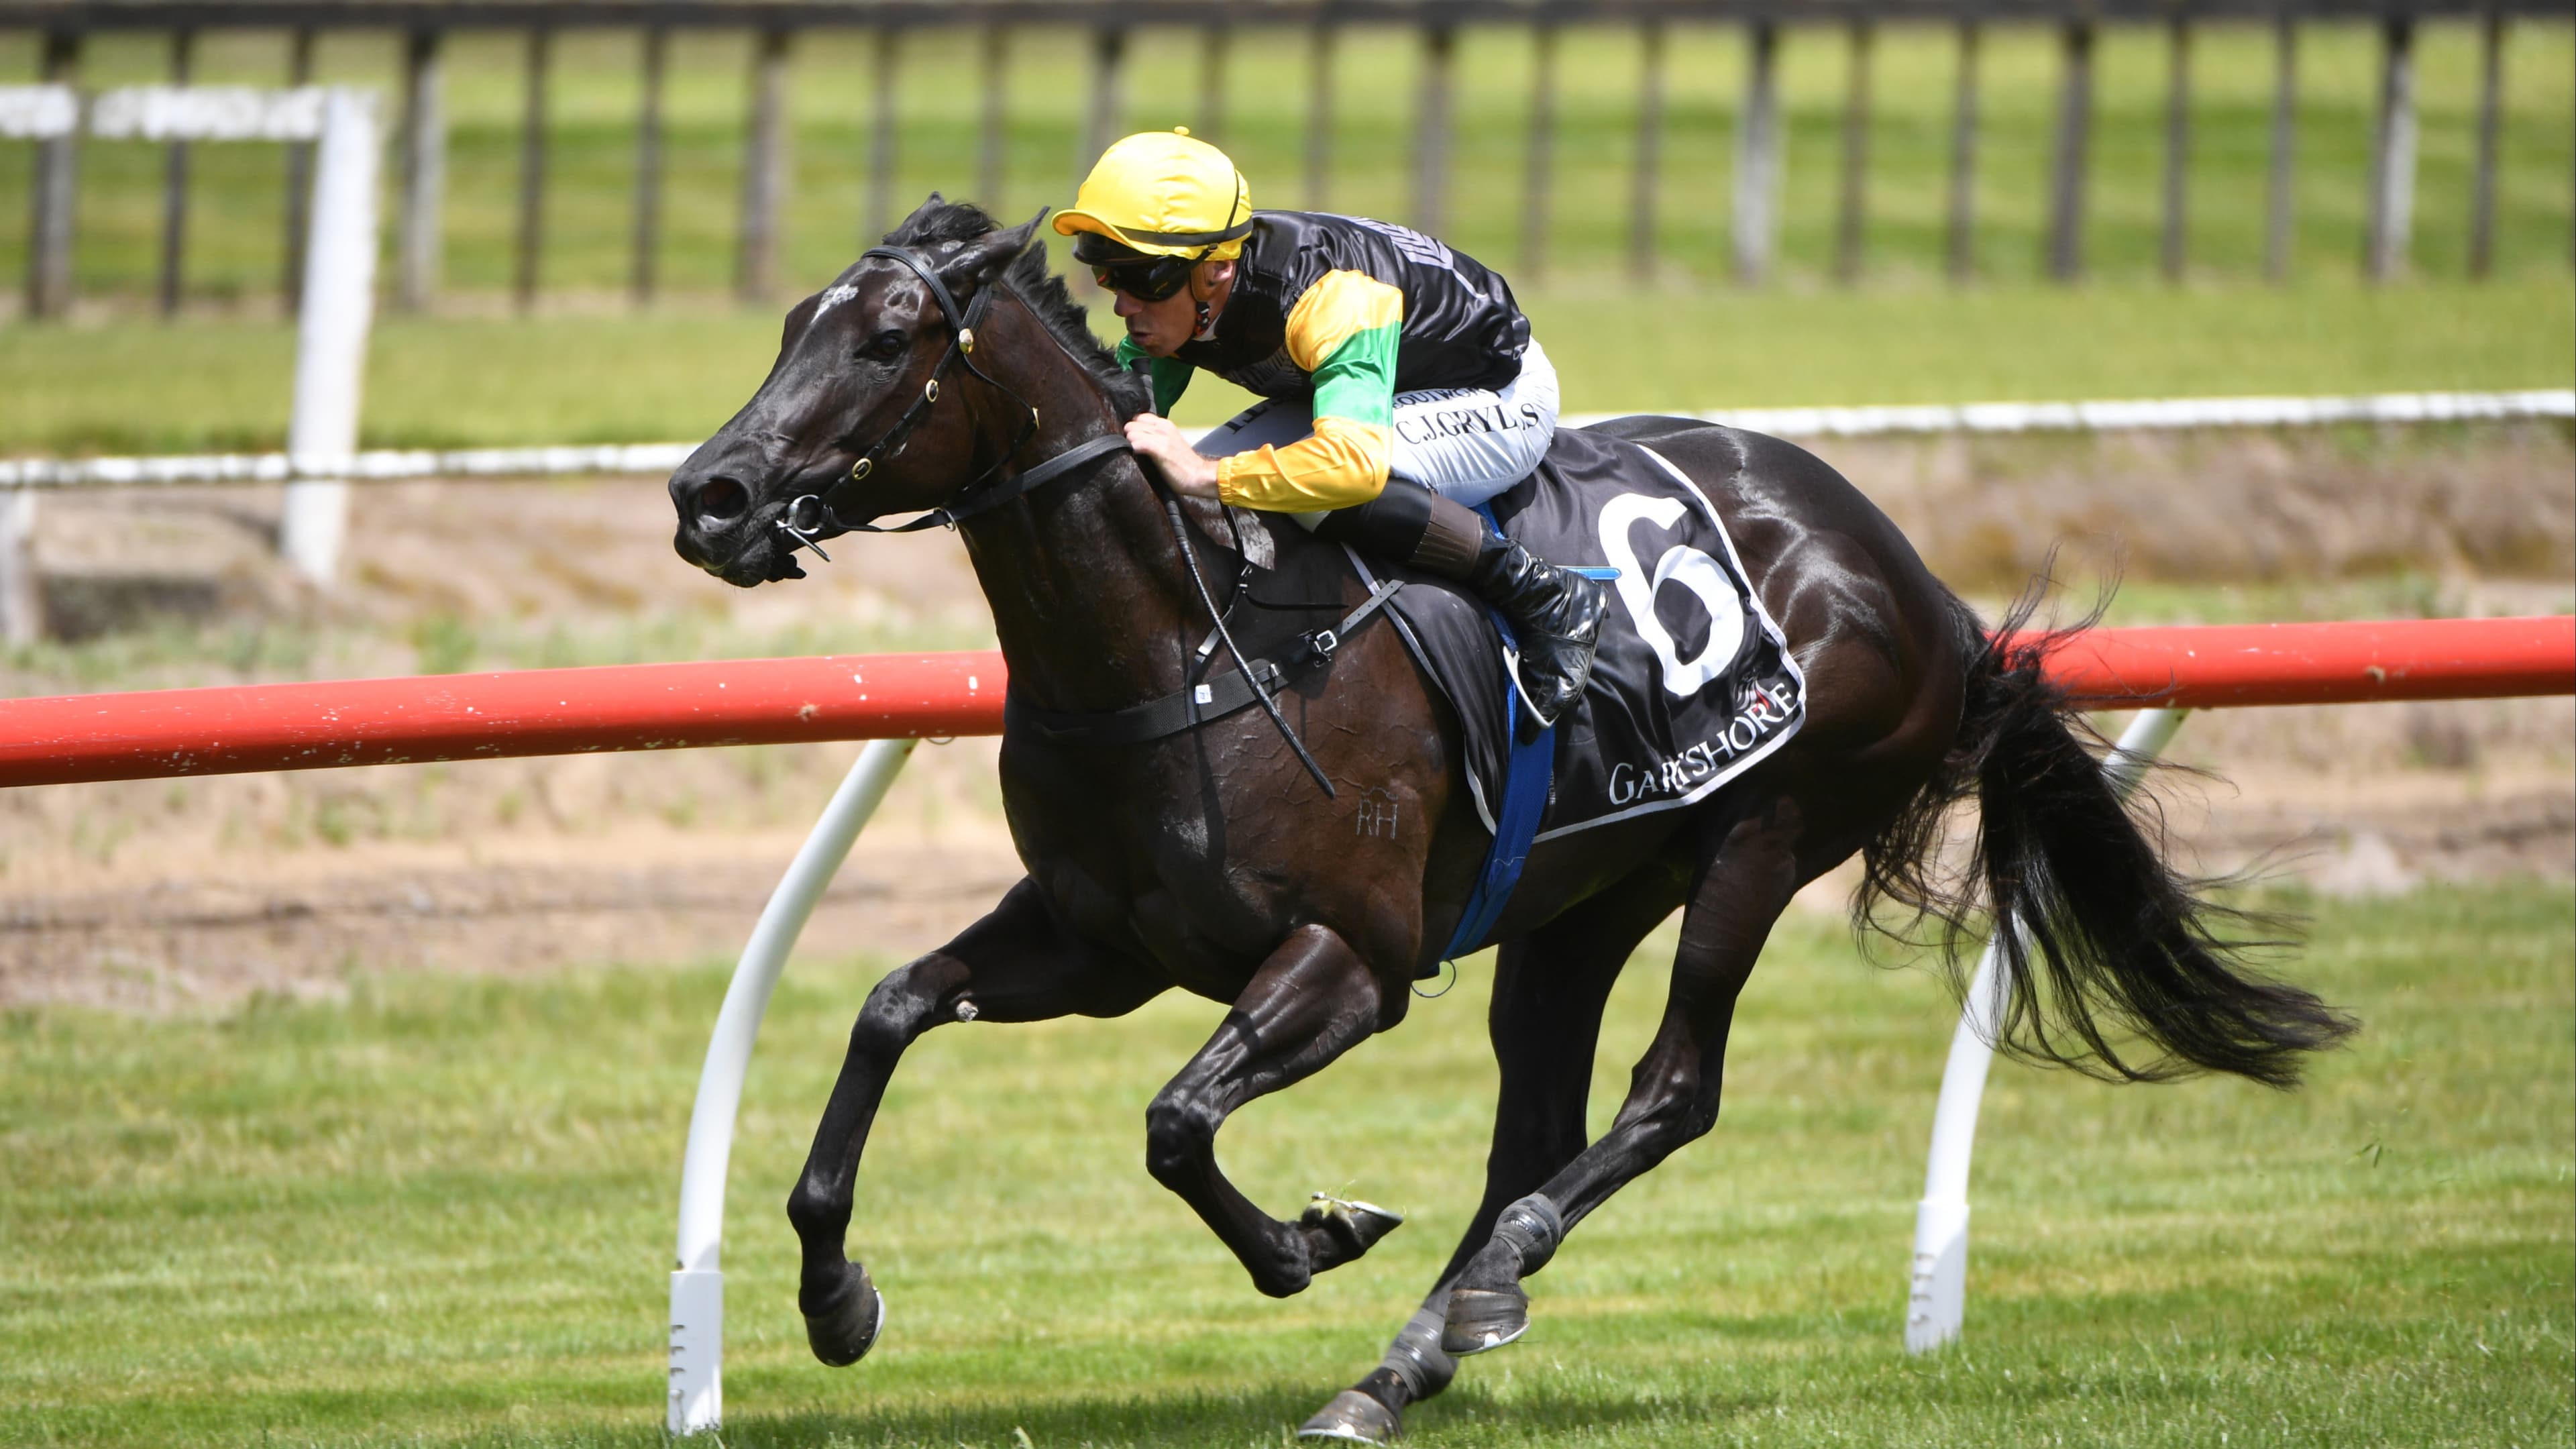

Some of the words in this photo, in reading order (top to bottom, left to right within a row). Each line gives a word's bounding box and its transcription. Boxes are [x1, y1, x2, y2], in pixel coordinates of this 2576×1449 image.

[1396, 403, 1539, 445] C.J.GRYLS
[1598, 493, 1744, 696] 6
[1356, 799, 1398, 839] RH
